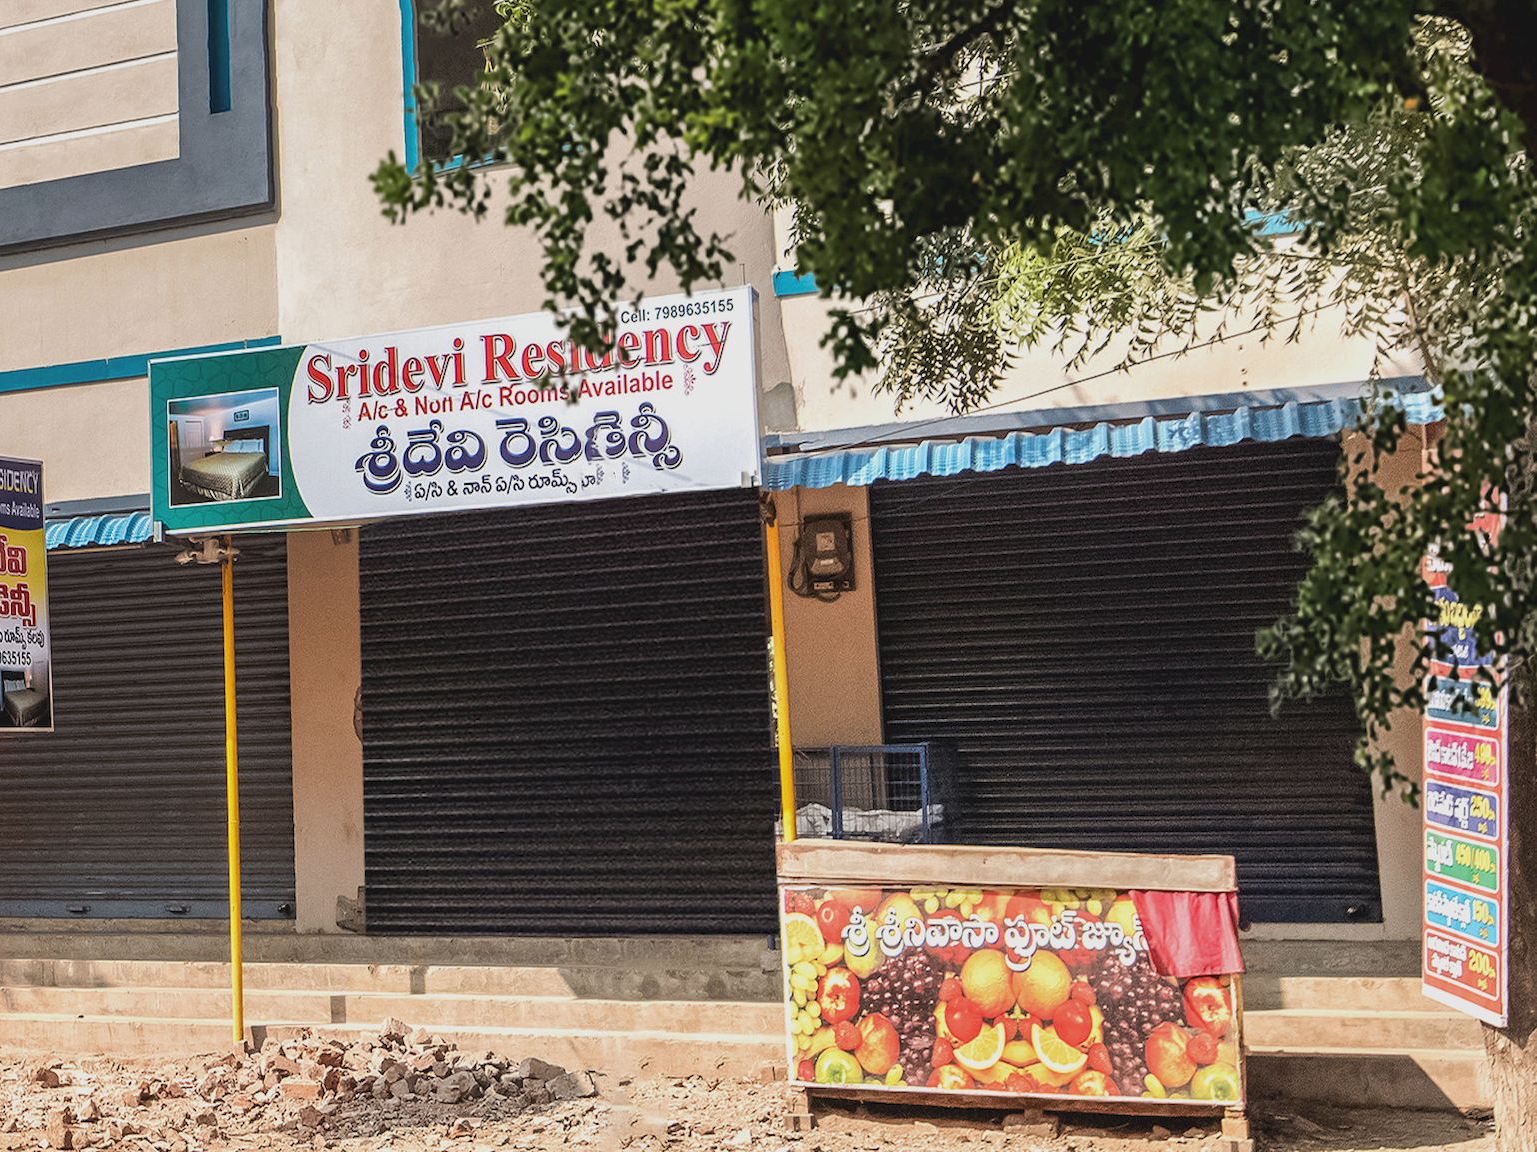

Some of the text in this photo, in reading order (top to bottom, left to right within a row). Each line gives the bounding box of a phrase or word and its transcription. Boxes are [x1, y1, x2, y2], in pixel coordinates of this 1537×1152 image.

[620, 298, 734, 324] Cell: 7989635155
[306, 337, 467, 405] Sridevi
[394, 399, 408, 419] &
[461, 389, 493, 413] A/c
[499, 381, 571, 408] Rooms
[577, 371, 674, 400] Available
[354, 419, 489, 496] శ్రీదేవి
[11, 501, 40, 519] Available
[447, 482, 459, 497] &
[841, 905, 871, 957] శ్రీ
